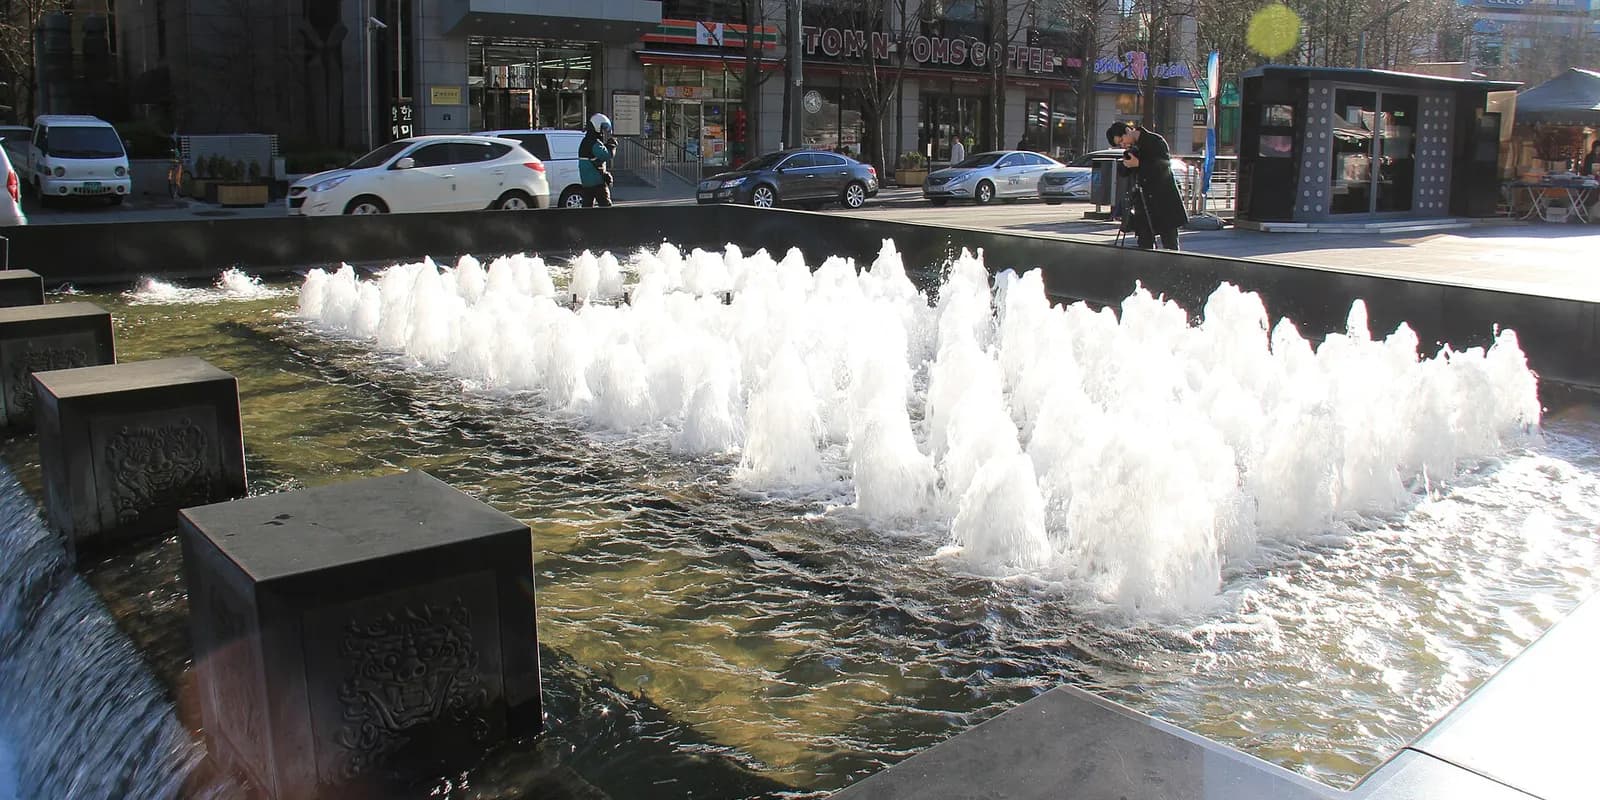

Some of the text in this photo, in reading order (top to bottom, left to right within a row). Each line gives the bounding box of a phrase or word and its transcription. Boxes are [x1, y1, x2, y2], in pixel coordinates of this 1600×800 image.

[802, 26, 866, 58] TOM
[871, 32, 889, 60] N
[898, 35, 966, 66] OMS
[399, 105, 414, 138] 한미
